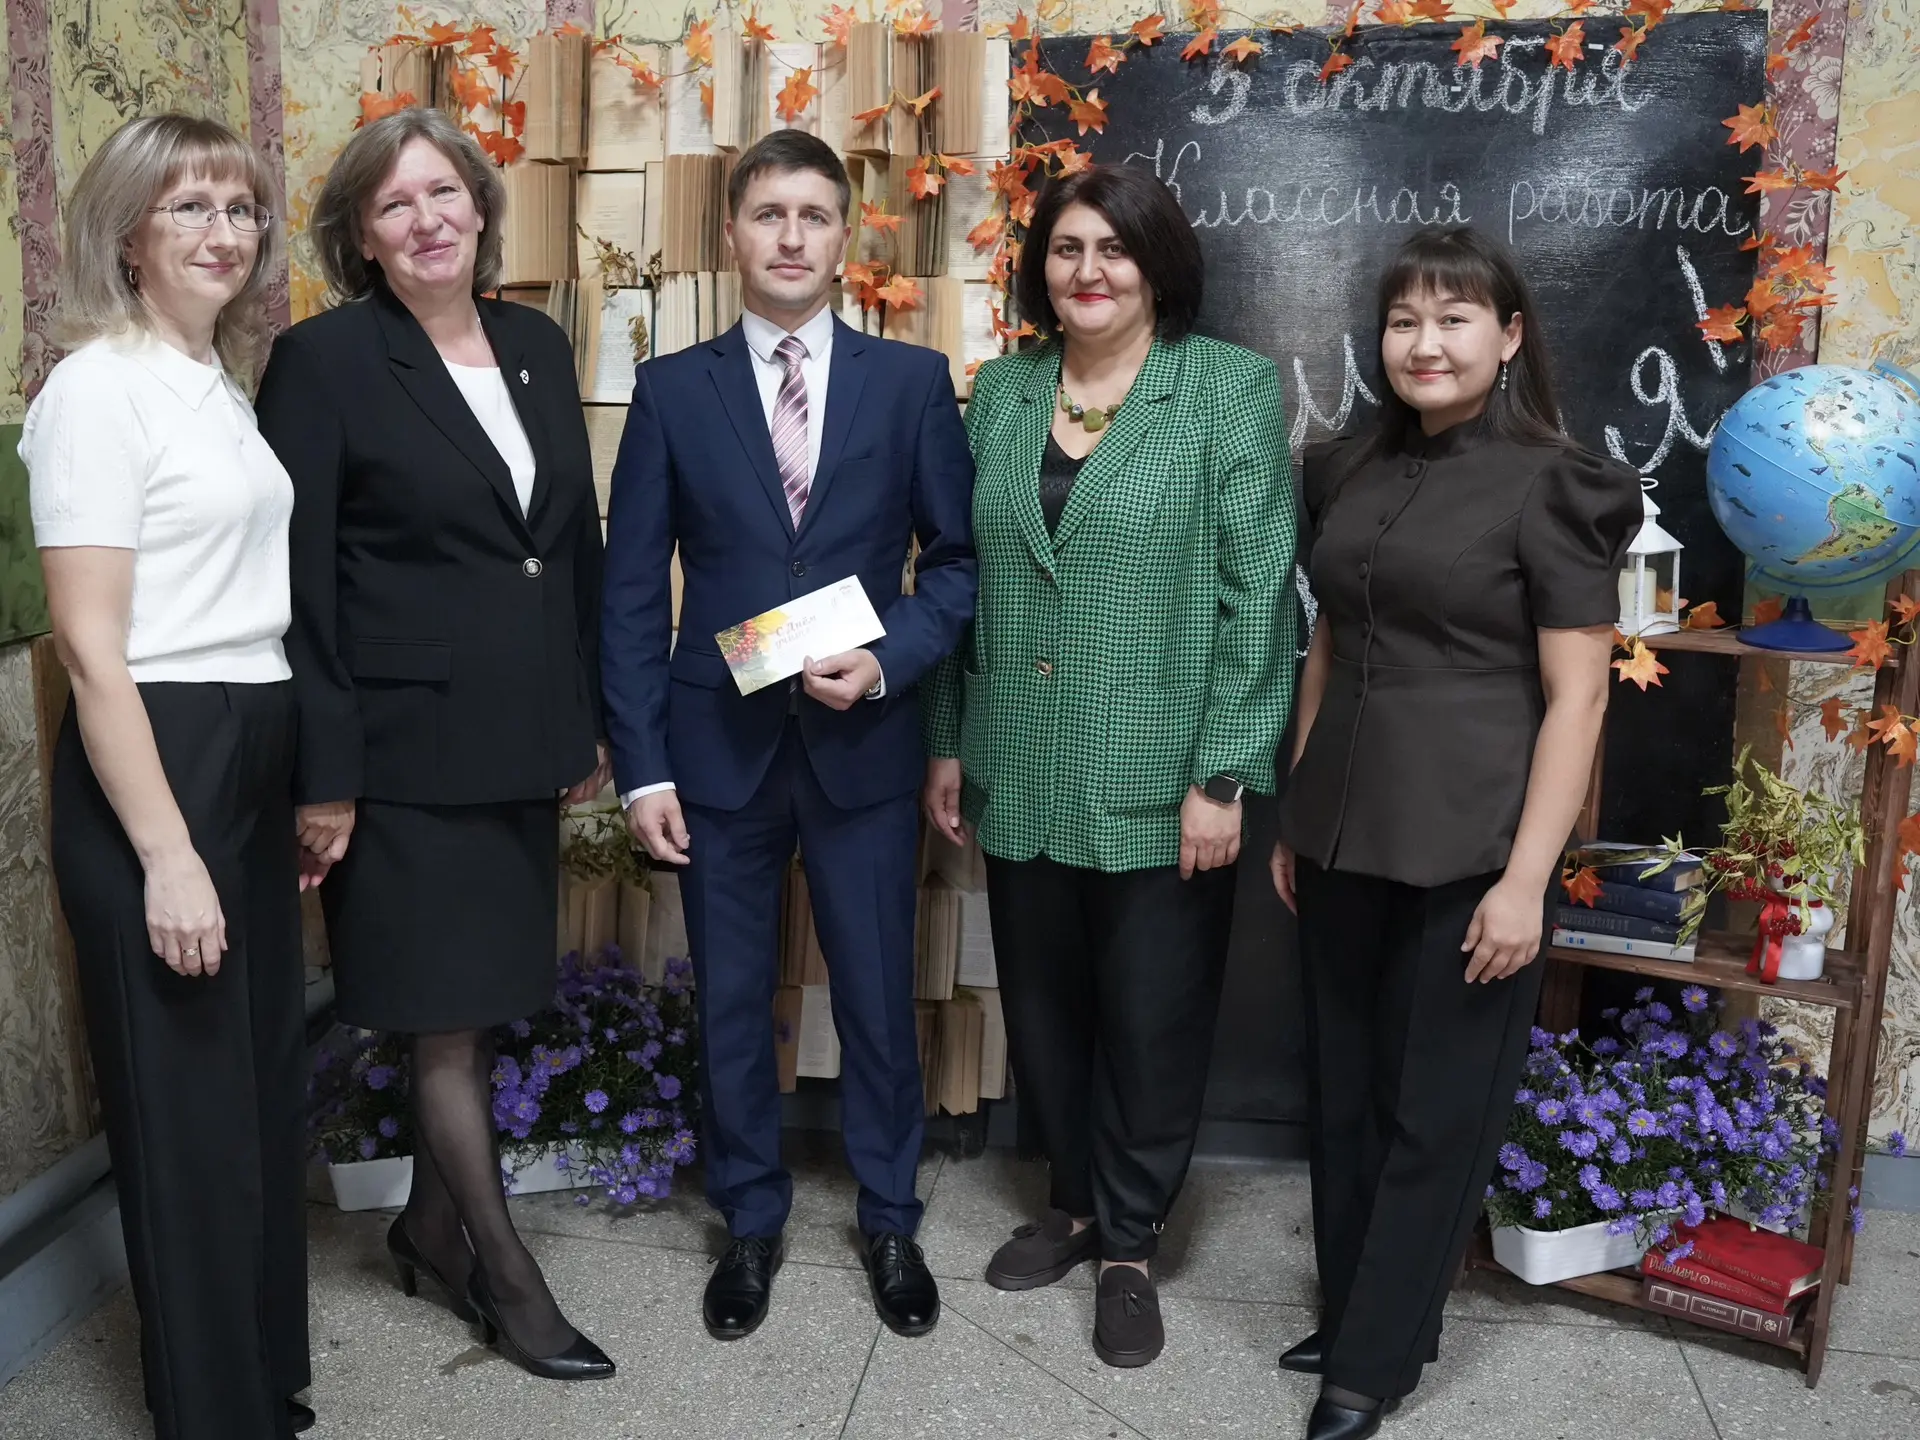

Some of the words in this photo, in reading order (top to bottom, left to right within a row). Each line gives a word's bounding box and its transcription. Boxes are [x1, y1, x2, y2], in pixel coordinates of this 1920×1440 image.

[1283, 35, 1655, 135] октября
[1122, 137, 1473, 229] Классная
[1507, 169, 1751, 245] работа
